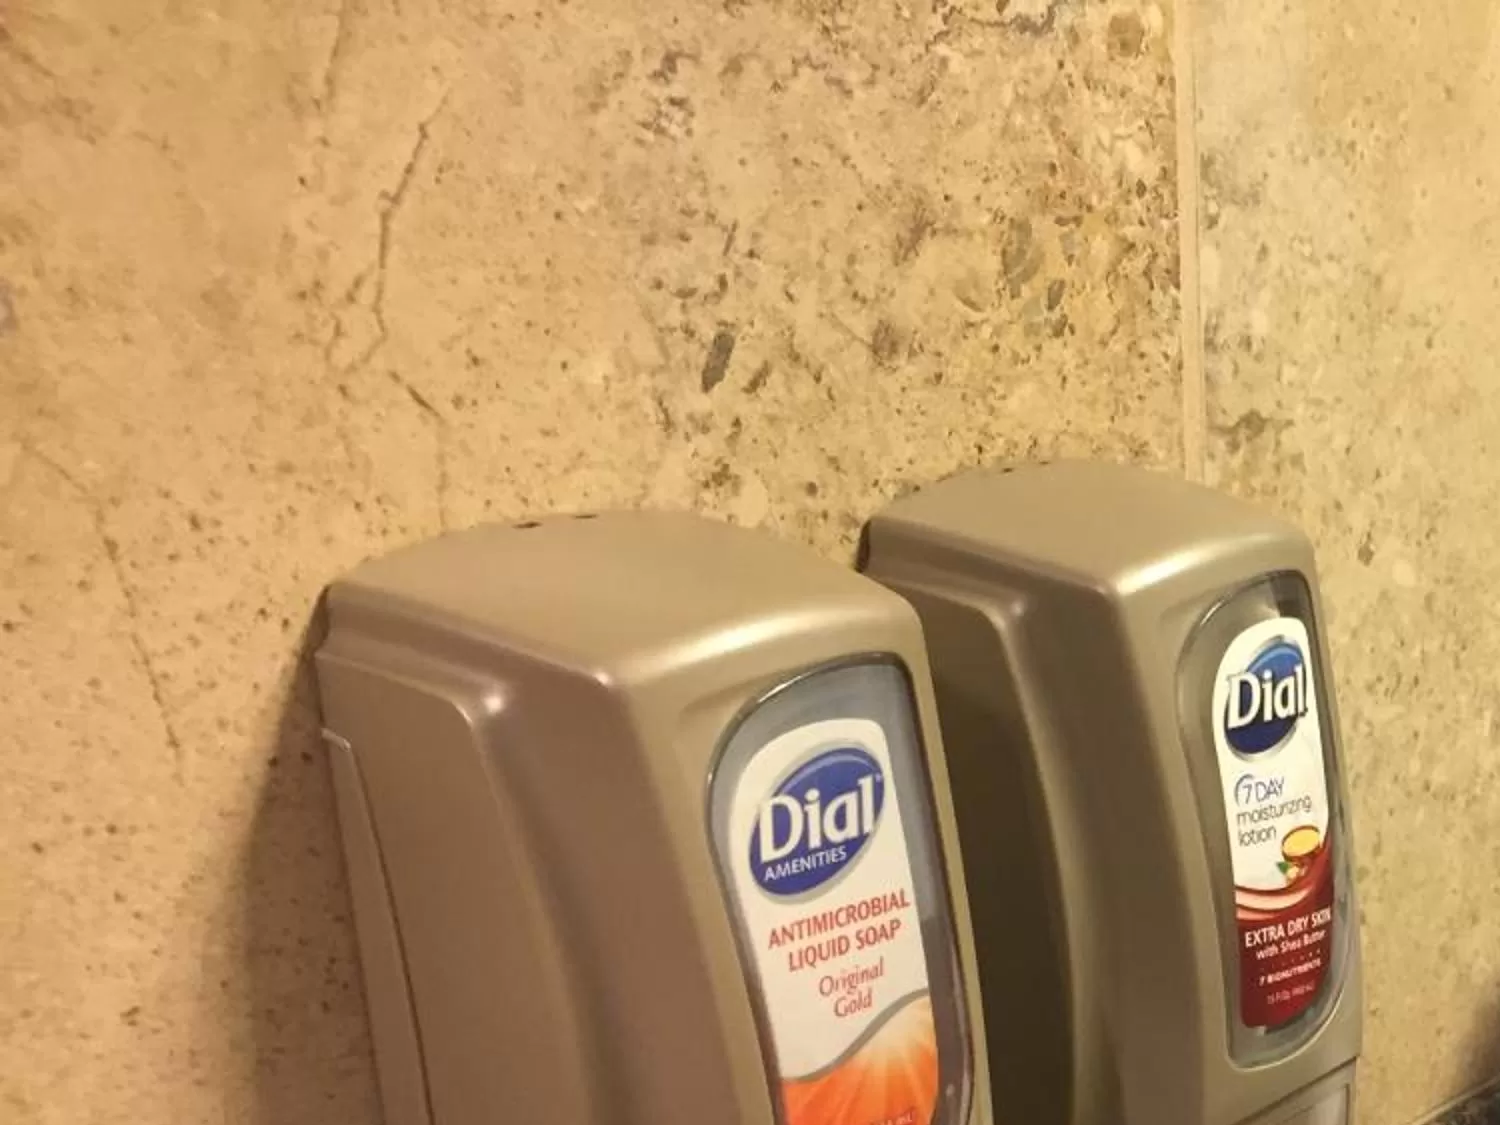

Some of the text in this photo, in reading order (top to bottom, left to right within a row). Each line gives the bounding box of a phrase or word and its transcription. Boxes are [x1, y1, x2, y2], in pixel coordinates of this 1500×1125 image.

[1227, 664, 1305, 729] Dial
[1236, 795, 1312, 826] moisturizing
[1241, 776, 1284, 805] 7 DAY
[758, 774, 874, 863] Dial
[1238, 826, 1277, 847] lotion
[764, 845, 847, 882] AMENITIES
[768, 888, 910, 949] ANTIMICROBIAL
[1244, 905, 1331, 948] EXTRA DRY SKIN
[789, 918, 902, 972] LIQUID SOAP
[819, 955, 884, 996] Original
[833, 987, 873, 1017] Gold
